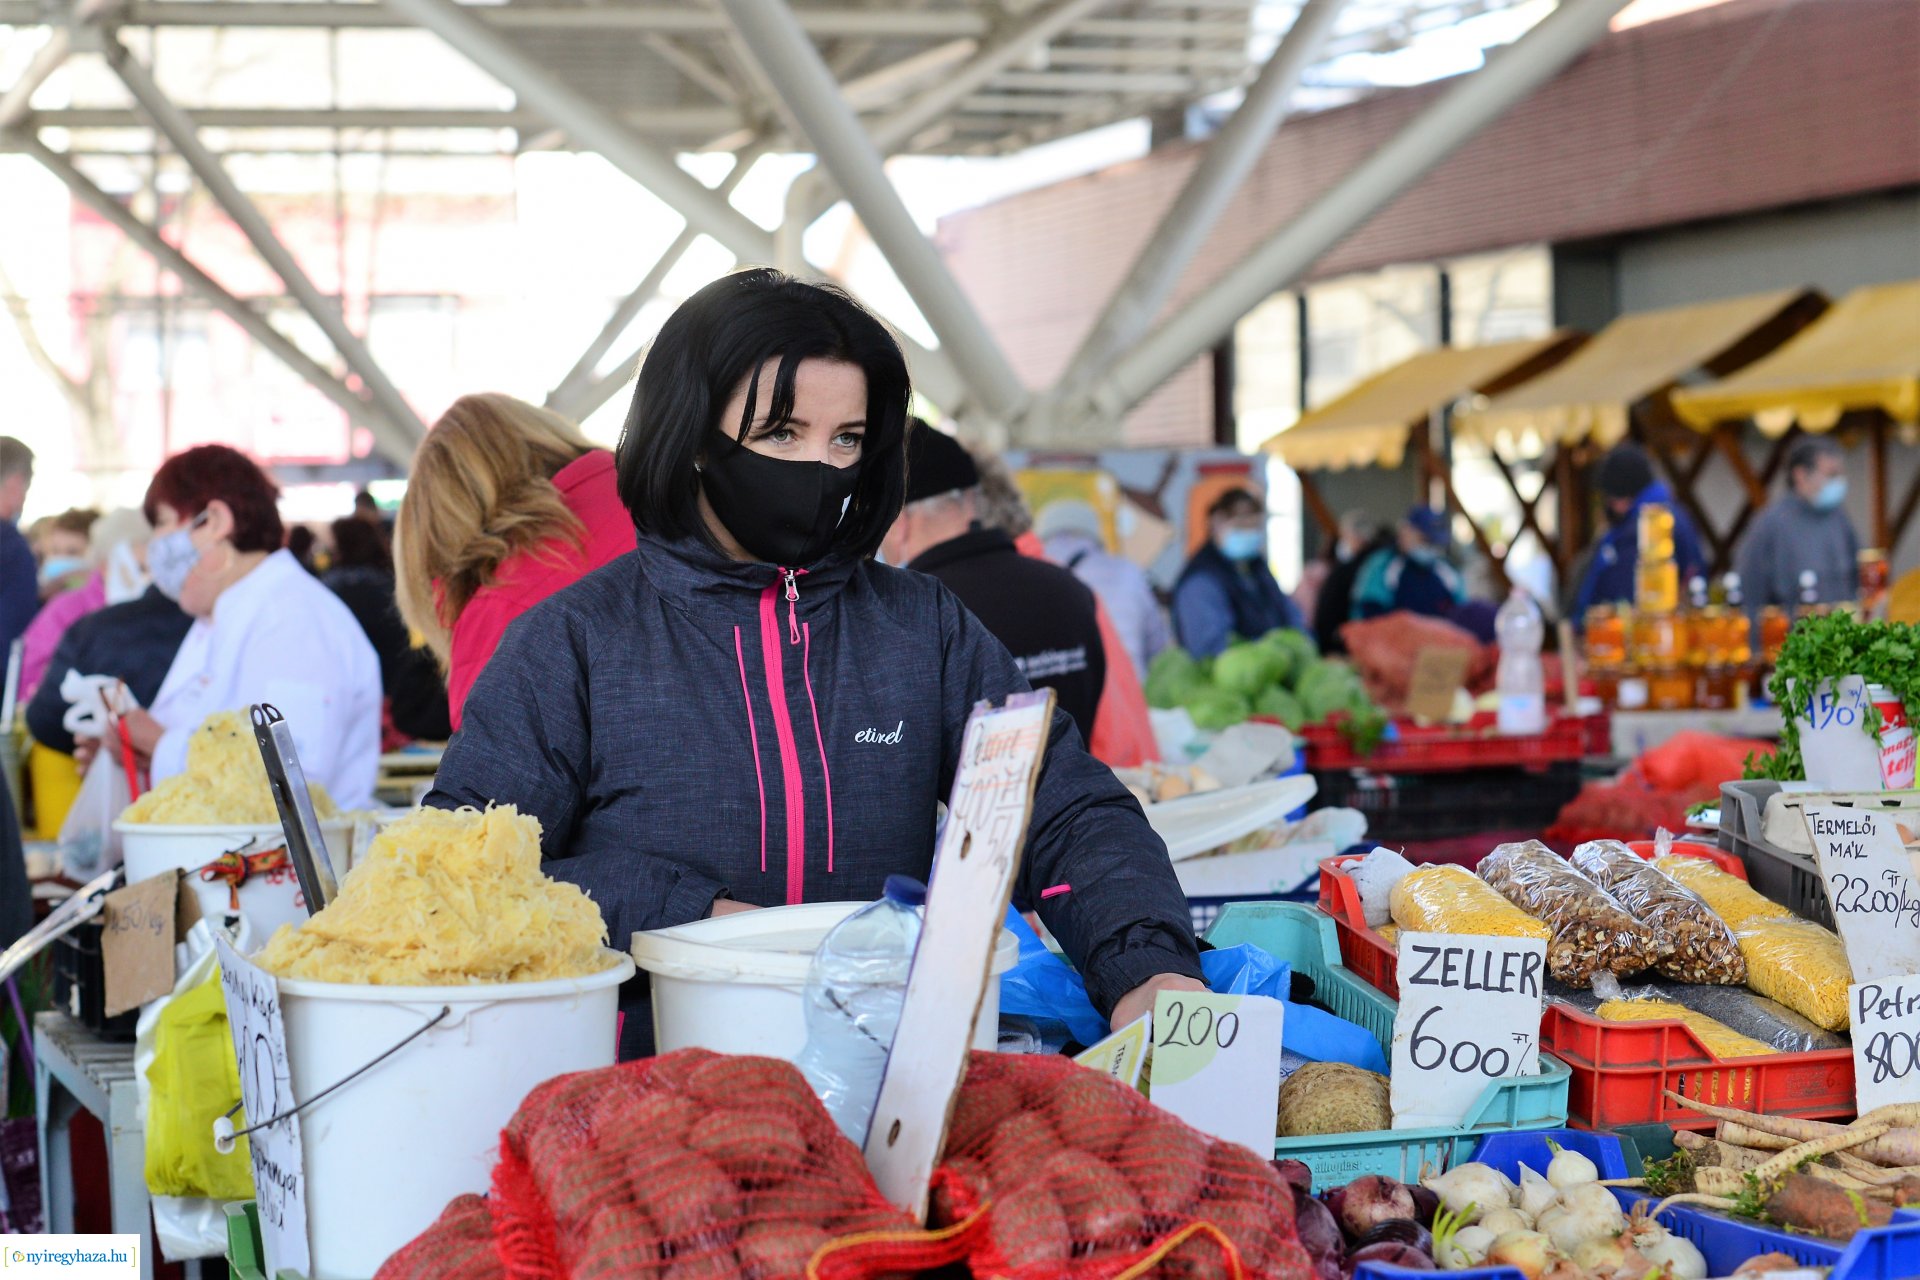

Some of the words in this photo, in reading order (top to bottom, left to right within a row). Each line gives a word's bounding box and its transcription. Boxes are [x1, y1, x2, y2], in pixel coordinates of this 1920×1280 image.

[1830, 841, 1868, 860] MÁK
[1409, 945, 1541, 998] ZELLER
[1158, 1001, 1240, 1048] 200
